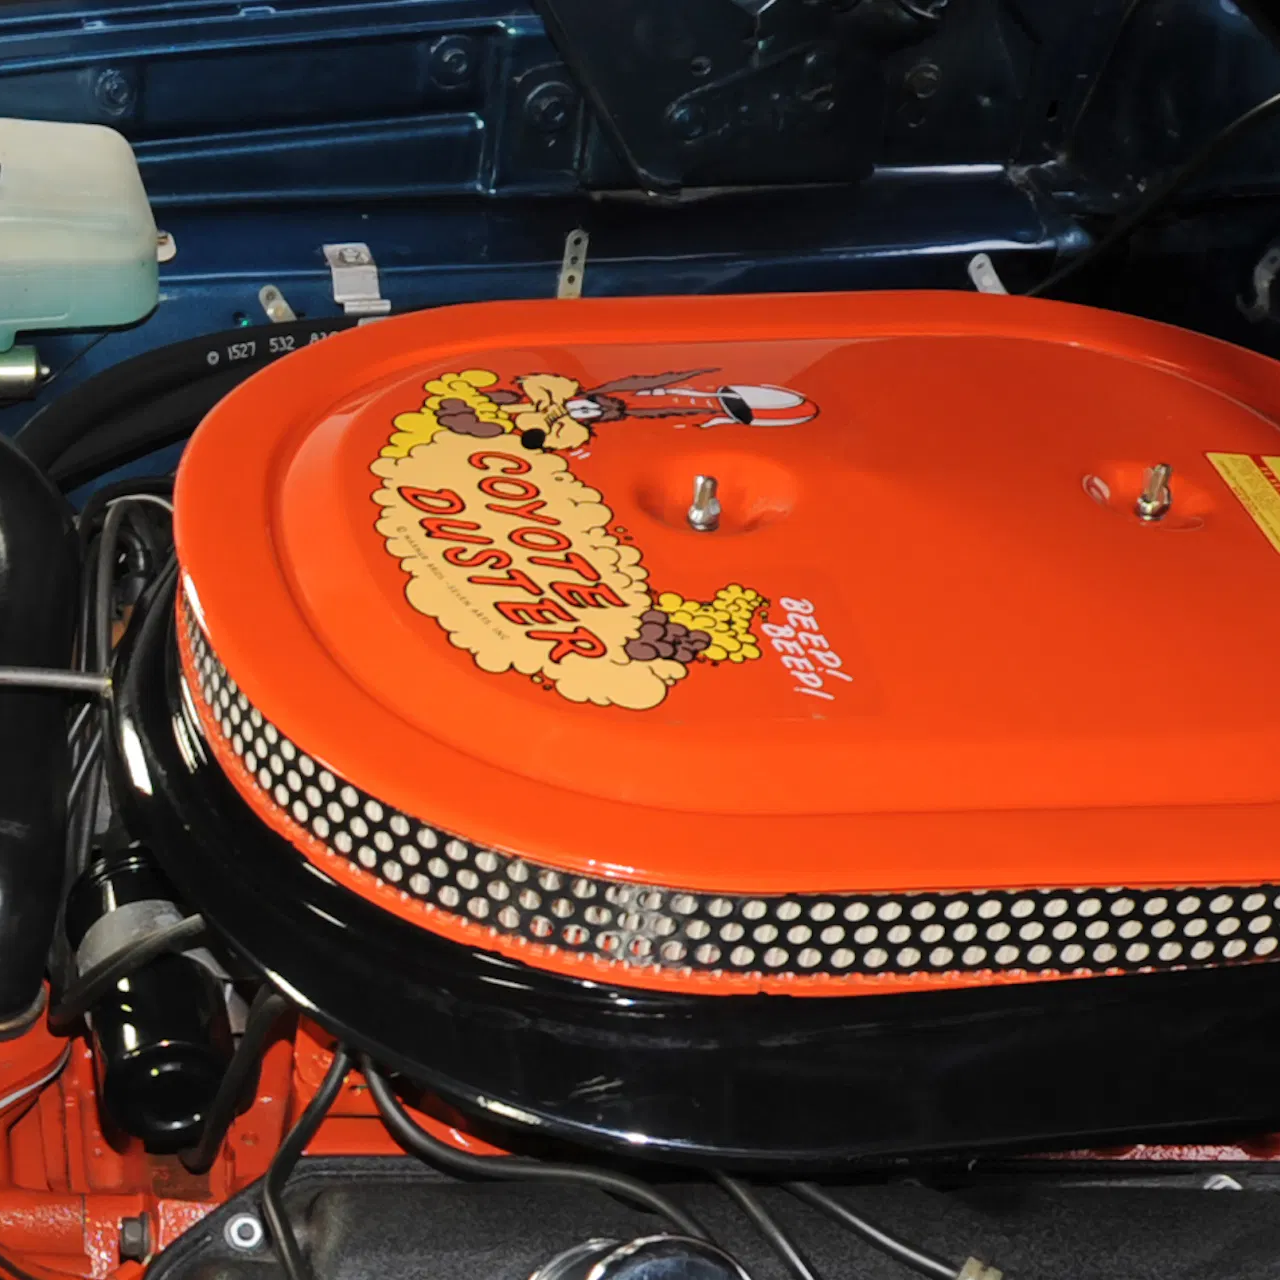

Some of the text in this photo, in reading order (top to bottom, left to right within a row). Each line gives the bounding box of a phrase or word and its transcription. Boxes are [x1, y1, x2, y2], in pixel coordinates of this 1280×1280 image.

[227, 340, 256, 361] 1527
[268, 335, 296, 353] 532
[397, 484, 608, 665] DUSTER
[467, 450, 630, 609] COYOTE
[760, 622, 835, 701] BEEP!
[778, 595, 854, 685] BEEP!
